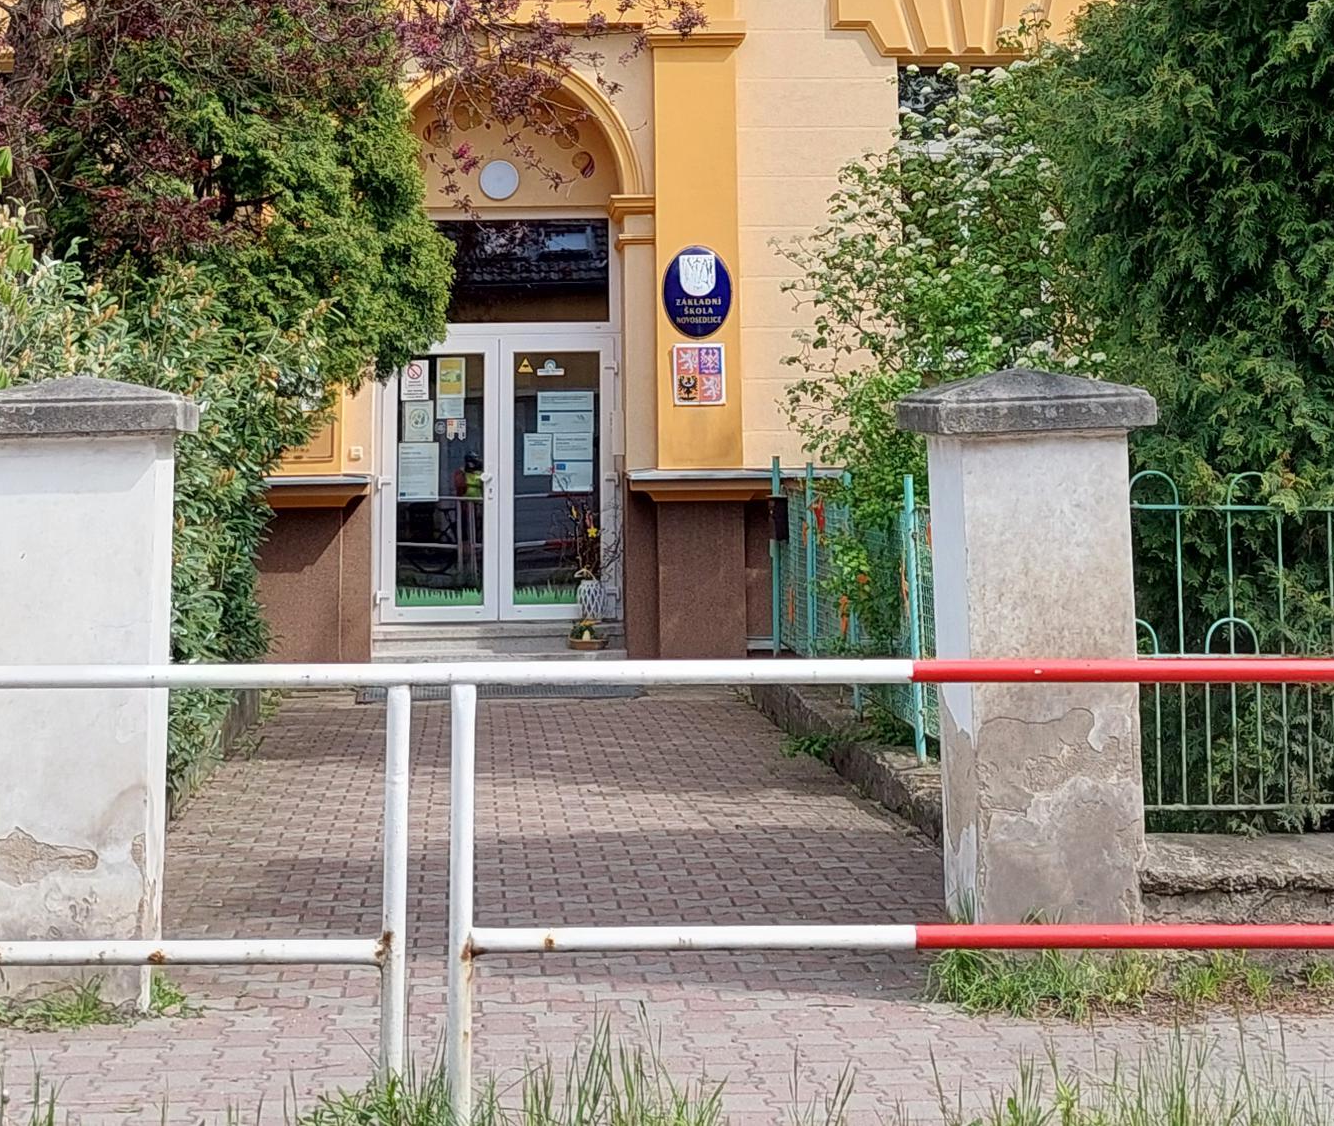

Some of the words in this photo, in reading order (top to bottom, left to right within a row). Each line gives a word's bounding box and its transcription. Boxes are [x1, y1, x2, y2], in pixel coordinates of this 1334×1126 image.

[675, 297, 722, 306] ZÁKLADNÍ
[683, 306, 714, 315] ŠKOLA
[676, 316, 722, 324] NOVOSEDLICE
